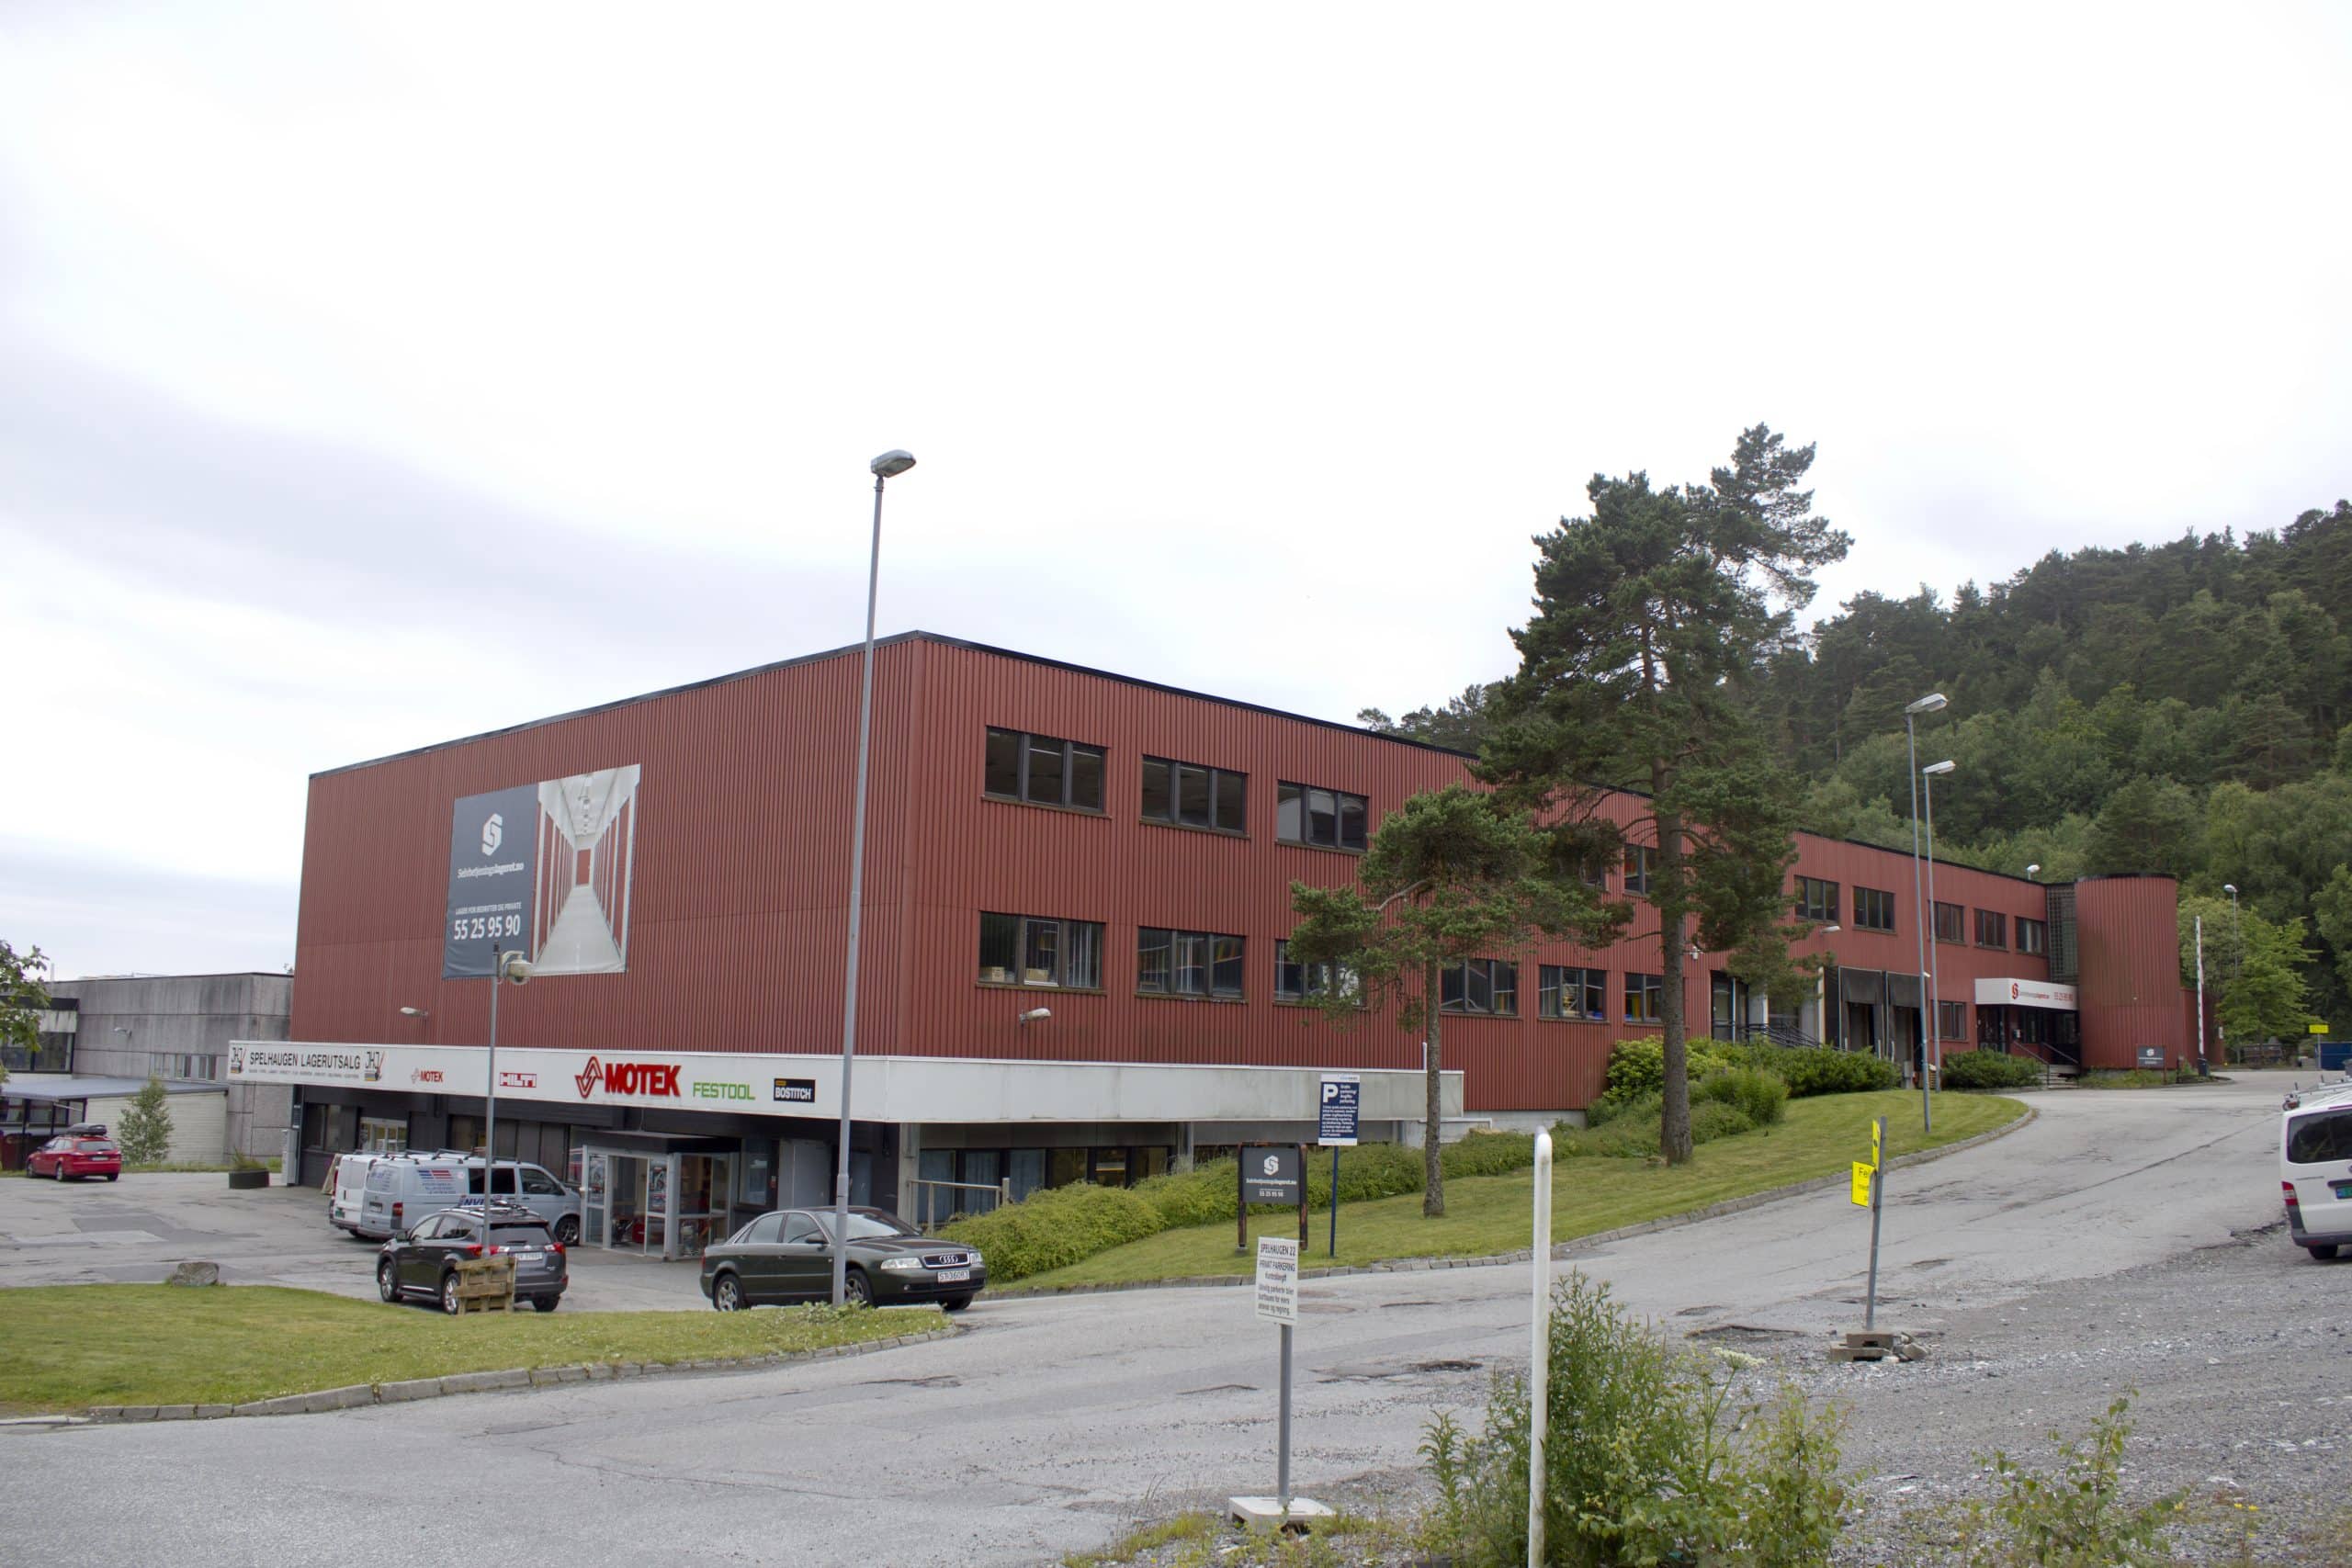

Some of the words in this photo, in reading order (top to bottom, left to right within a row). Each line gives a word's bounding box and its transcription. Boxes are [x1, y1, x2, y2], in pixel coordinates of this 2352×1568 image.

[454, 919, 468, 941] 55
[470, 918, 485, 939] 25
[488, 916, 503, 937] 95
[505, 914, 521, 936] 90
[250, 1052, 299, 1066] SPELHAUGEN
[300, 1054, 361, 1069] LAGERUTSALG
[420, 1070, 444, 1082] MOTEK
[500, 1072, 537, 1088] HILTI
[604, 1063, 682, 1097] MOTEK
[693, 1082, 756, 1100] FESTOOL
[775, 1087, 811, 1100] BOSTITCH
[1323, 1084, 1339, 1103] P
[1261, 1244, 1288, 1255] SPELHAUGEN
[1289, 1246, 1296, 1257] 22
[1272, 1261, 1295, 1271] PARKERING
